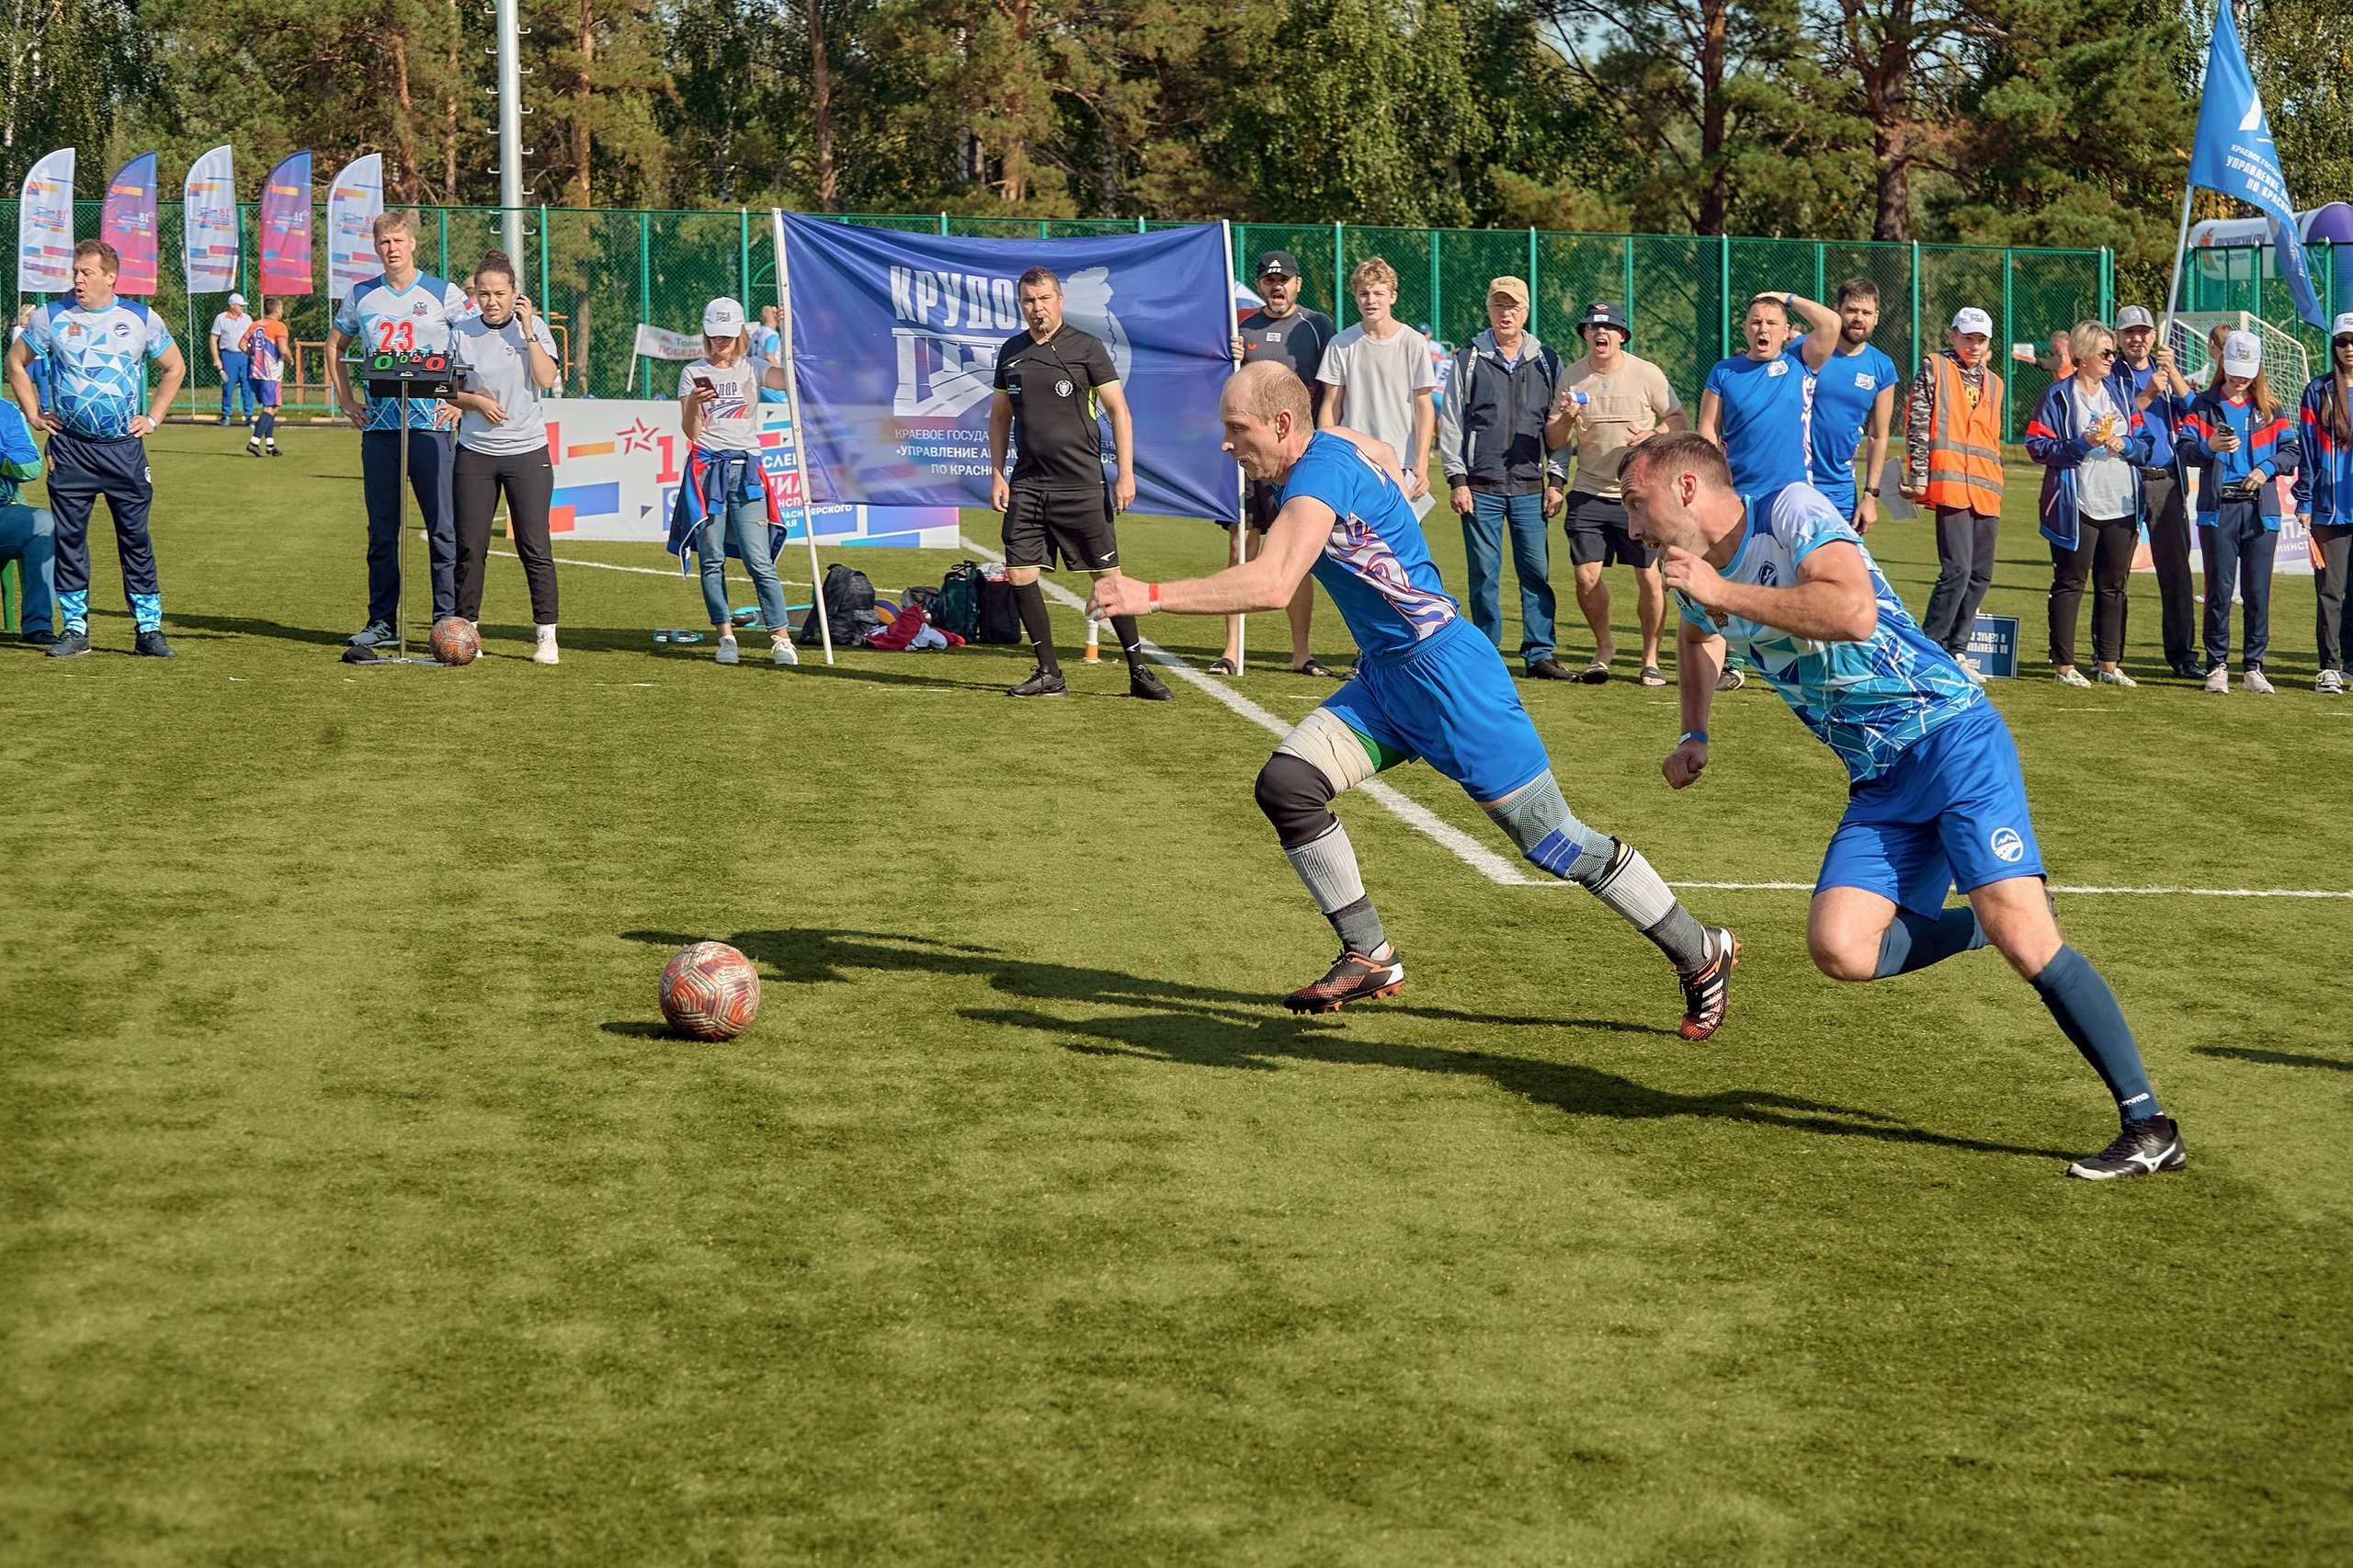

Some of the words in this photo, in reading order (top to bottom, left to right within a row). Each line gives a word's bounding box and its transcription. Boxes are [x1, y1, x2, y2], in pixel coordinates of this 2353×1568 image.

[2225, 155, 2280, 192] УПРАВЛЕНИЕ
[2245, 177, 2260, 193] ПО
[890, 266, 1029, 330] КРУДО
[379, 321, 415, 352] 23
[658, 344, 704, 357] ПОБЕДА
[373, 355, 393, 370] 0
[399, 354, 409, 364] 0
[426, 357, 446, 370] 0
[894, 428, 945, 440] КРАЕВОЕ
[895, 445, 979, 459] «УПРАВЛЕНИЕ
[931, 463, 948, 474] ПО
